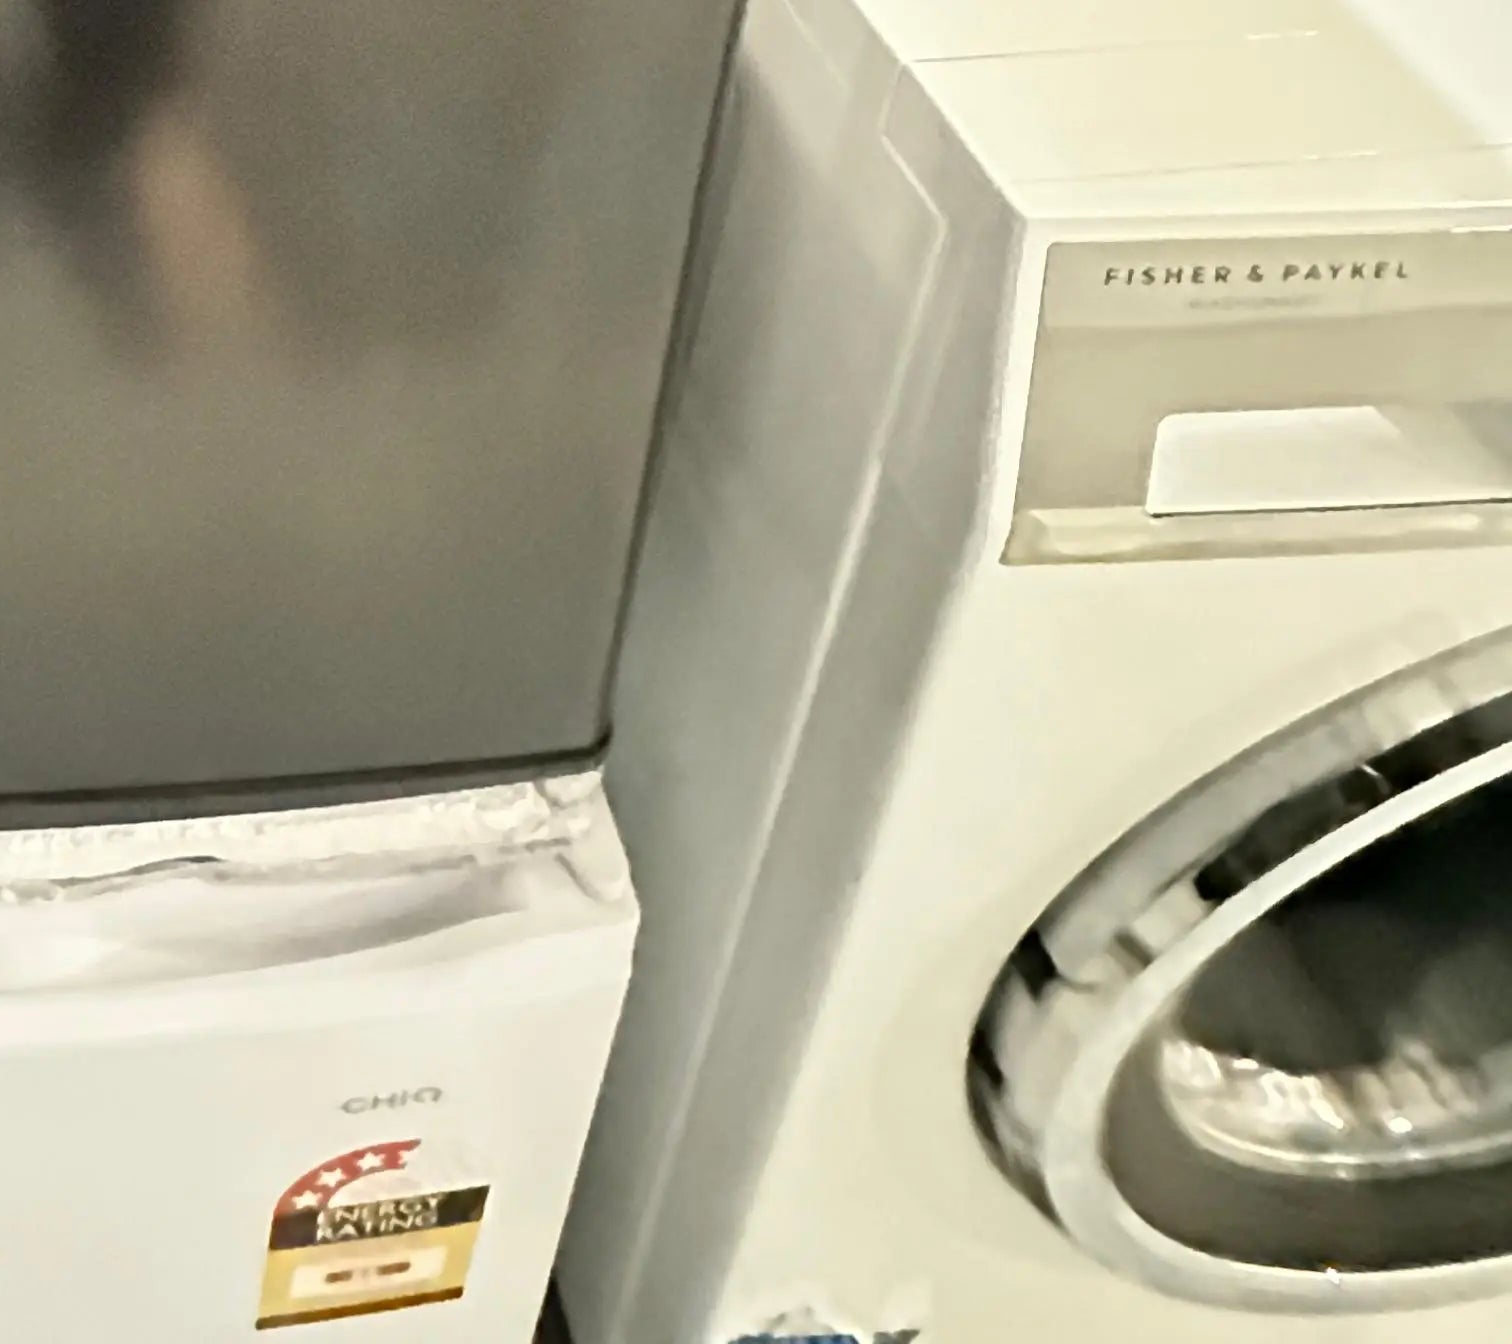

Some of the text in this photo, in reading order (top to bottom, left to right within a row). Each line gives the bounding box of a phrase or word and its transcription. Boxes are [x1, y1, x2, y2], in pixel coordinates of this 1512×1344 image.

[1104, 262, 1408, 286] FISHER & PAYKEL
